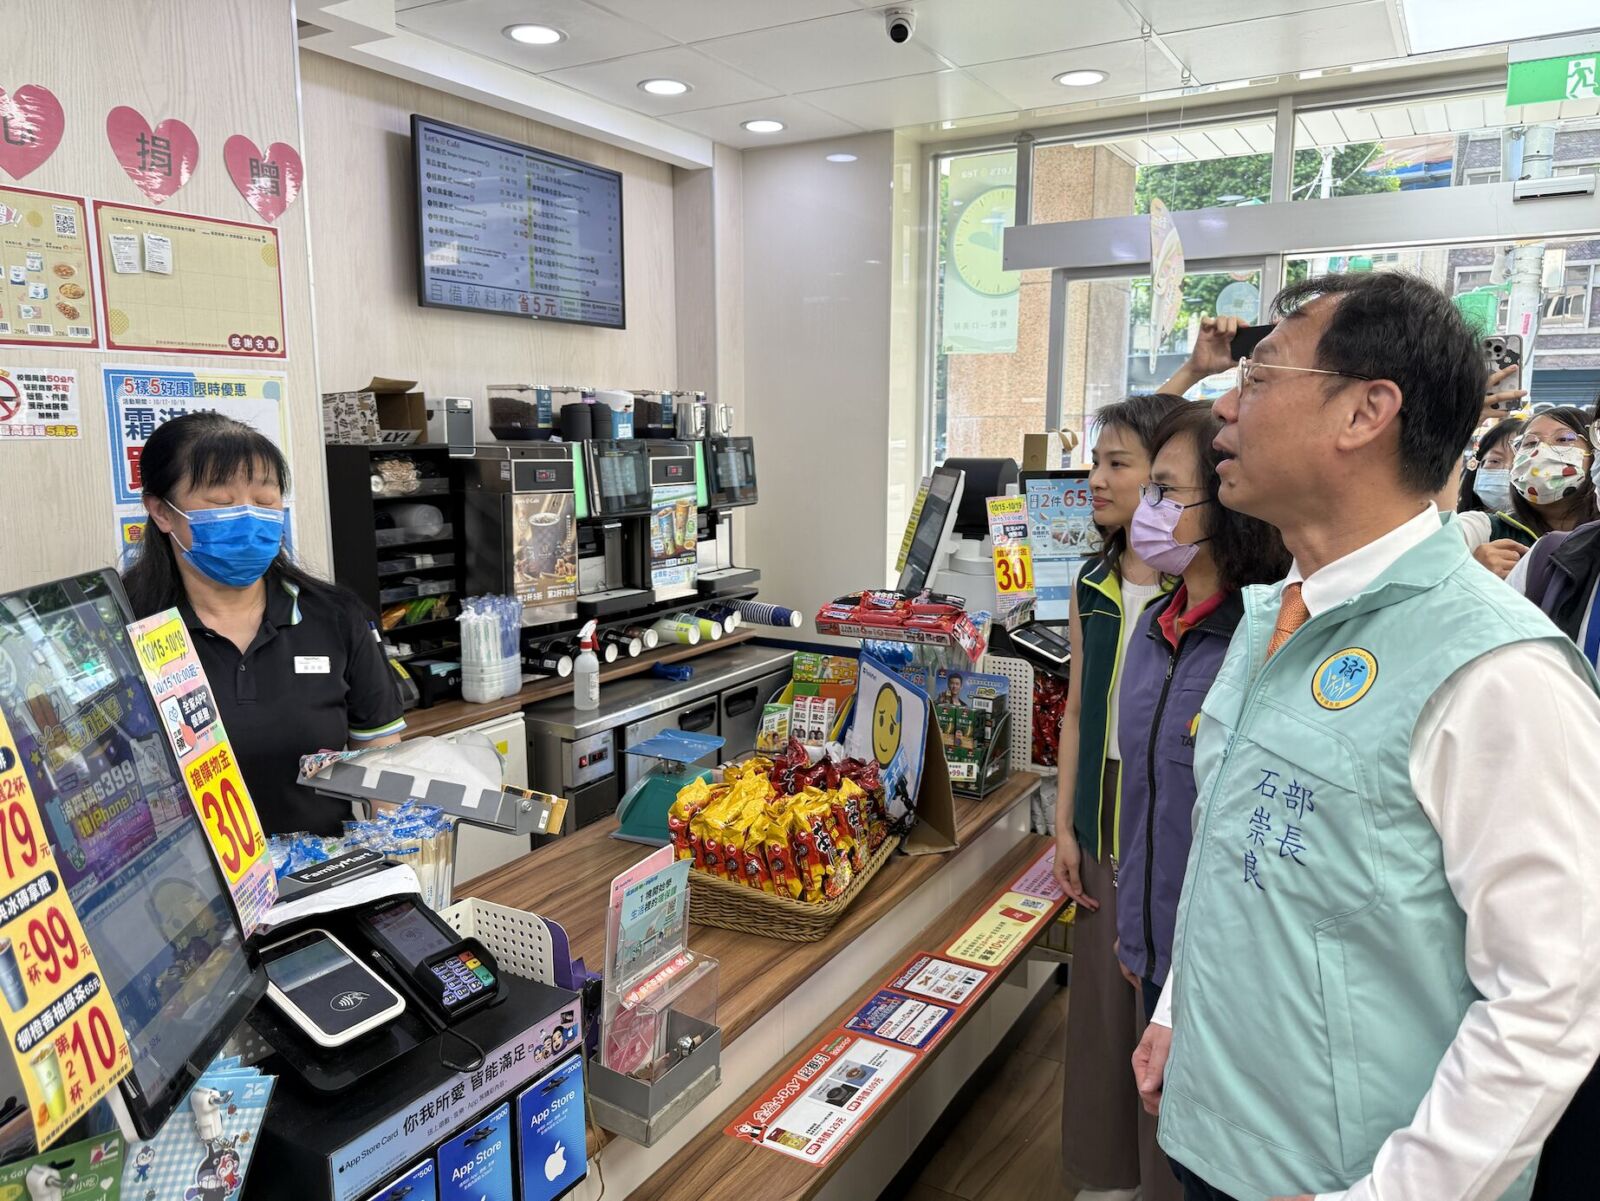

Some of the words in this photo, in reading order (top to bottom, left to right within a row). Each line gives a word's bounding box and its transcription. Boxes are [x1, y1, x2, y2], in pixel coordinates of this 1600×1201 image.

[231, 337, 277, 350] 感謝名單
[193, 382, 247, 397] 限時優惠
[997, 558, 1027, 591] 30
[189, 748, 232, 791] 搶購物金
[202, 777, 256, 874] 30
[254, 831, 265, 851] 元
[1243, 768, 1280, 891] 石崇良
[1275, 779, 1315, 867] 部長
[39, 842, 51, 861] 元
[300, 850, 374, 882] FamilyMart
[19, 941, 42, 987] 2杯
[27, 905, 79, 985] 99
[80, 942, 92, 961] 元
[54, 1032, 84, 1105] 第2杯
[70, 1005, 117, 1086] 10
[118, 1041, 129, 1061] 元
[402, 1081, 467, 1137] 你我所愛
[470, 1043, 527, 1092] 皆能滿足
[530, 1106, 551, 1127] App
[550, 1089, 576, 1110] Store
[345, 1152, 362, 1171] App
[360, 1139, 382, 1161] Store
[380, 1129, 399, 1147] Card
[451, 1157, 475, 1182] App
[474, 1139, 502, 1164] Store
